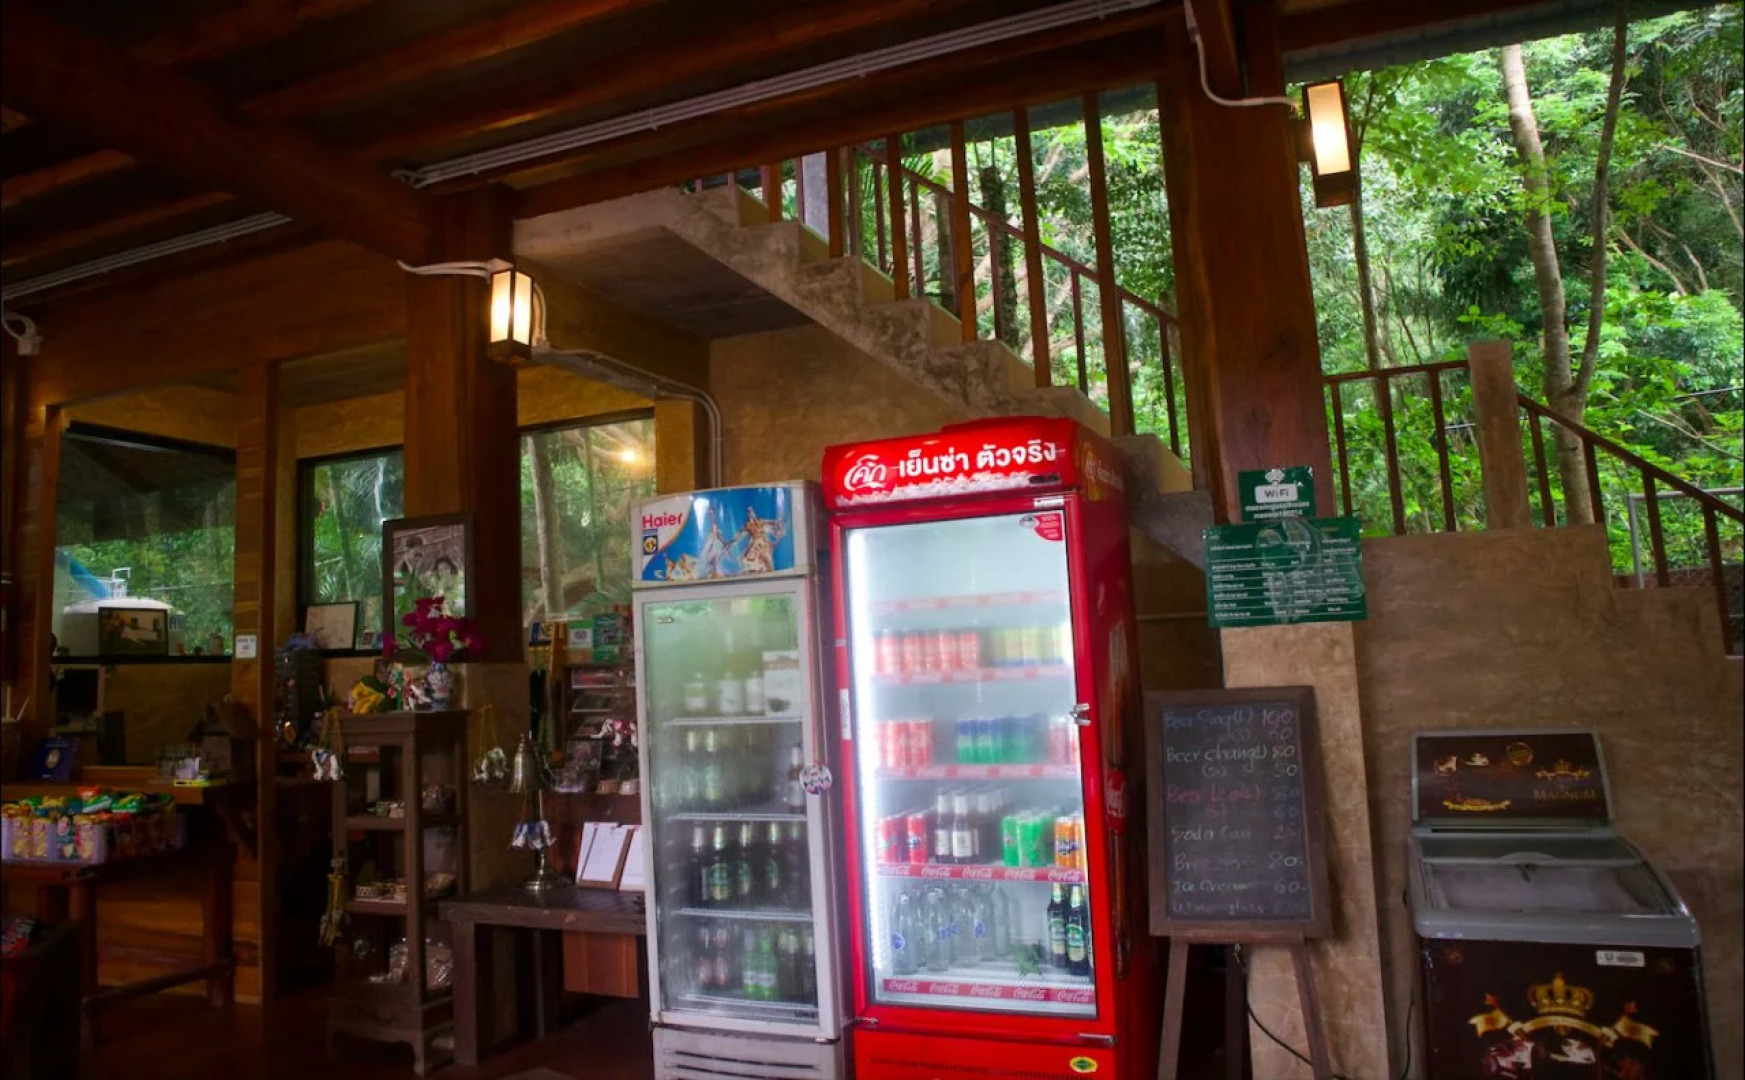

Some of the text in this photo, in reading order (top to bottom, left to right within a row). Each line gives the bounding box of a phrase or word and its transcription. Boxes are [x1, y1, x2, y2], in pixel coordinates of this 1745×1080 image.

[899, 446, 970, 477] เย็นซ่า
[976, 439, 1057, 469] ตัวจริง
[641, 511, 683, 529] Haier
[1166, 745, 1200, 763] Beer
